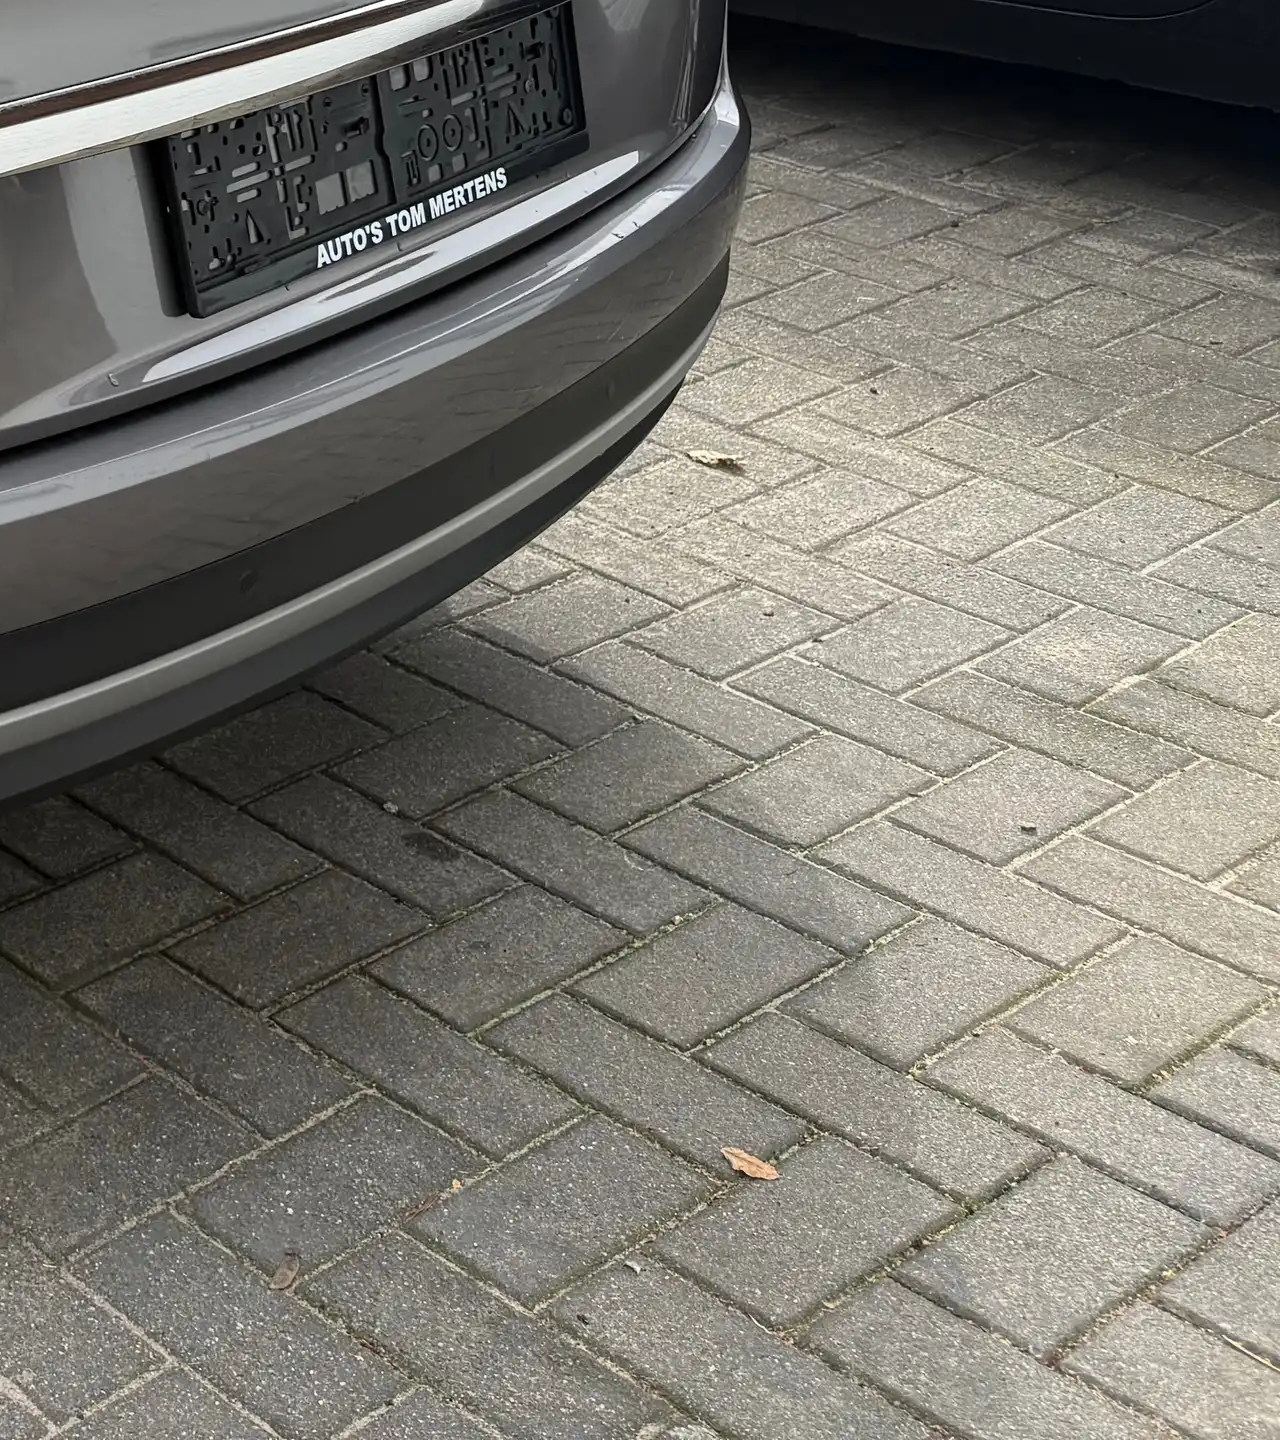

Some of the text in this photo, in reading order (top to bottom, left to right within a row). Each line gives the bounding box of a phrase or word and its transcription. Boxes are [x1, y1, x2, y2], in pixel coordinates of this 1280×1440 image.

[316, 167, 508, 268] AUTO'S TOM MERTENS
